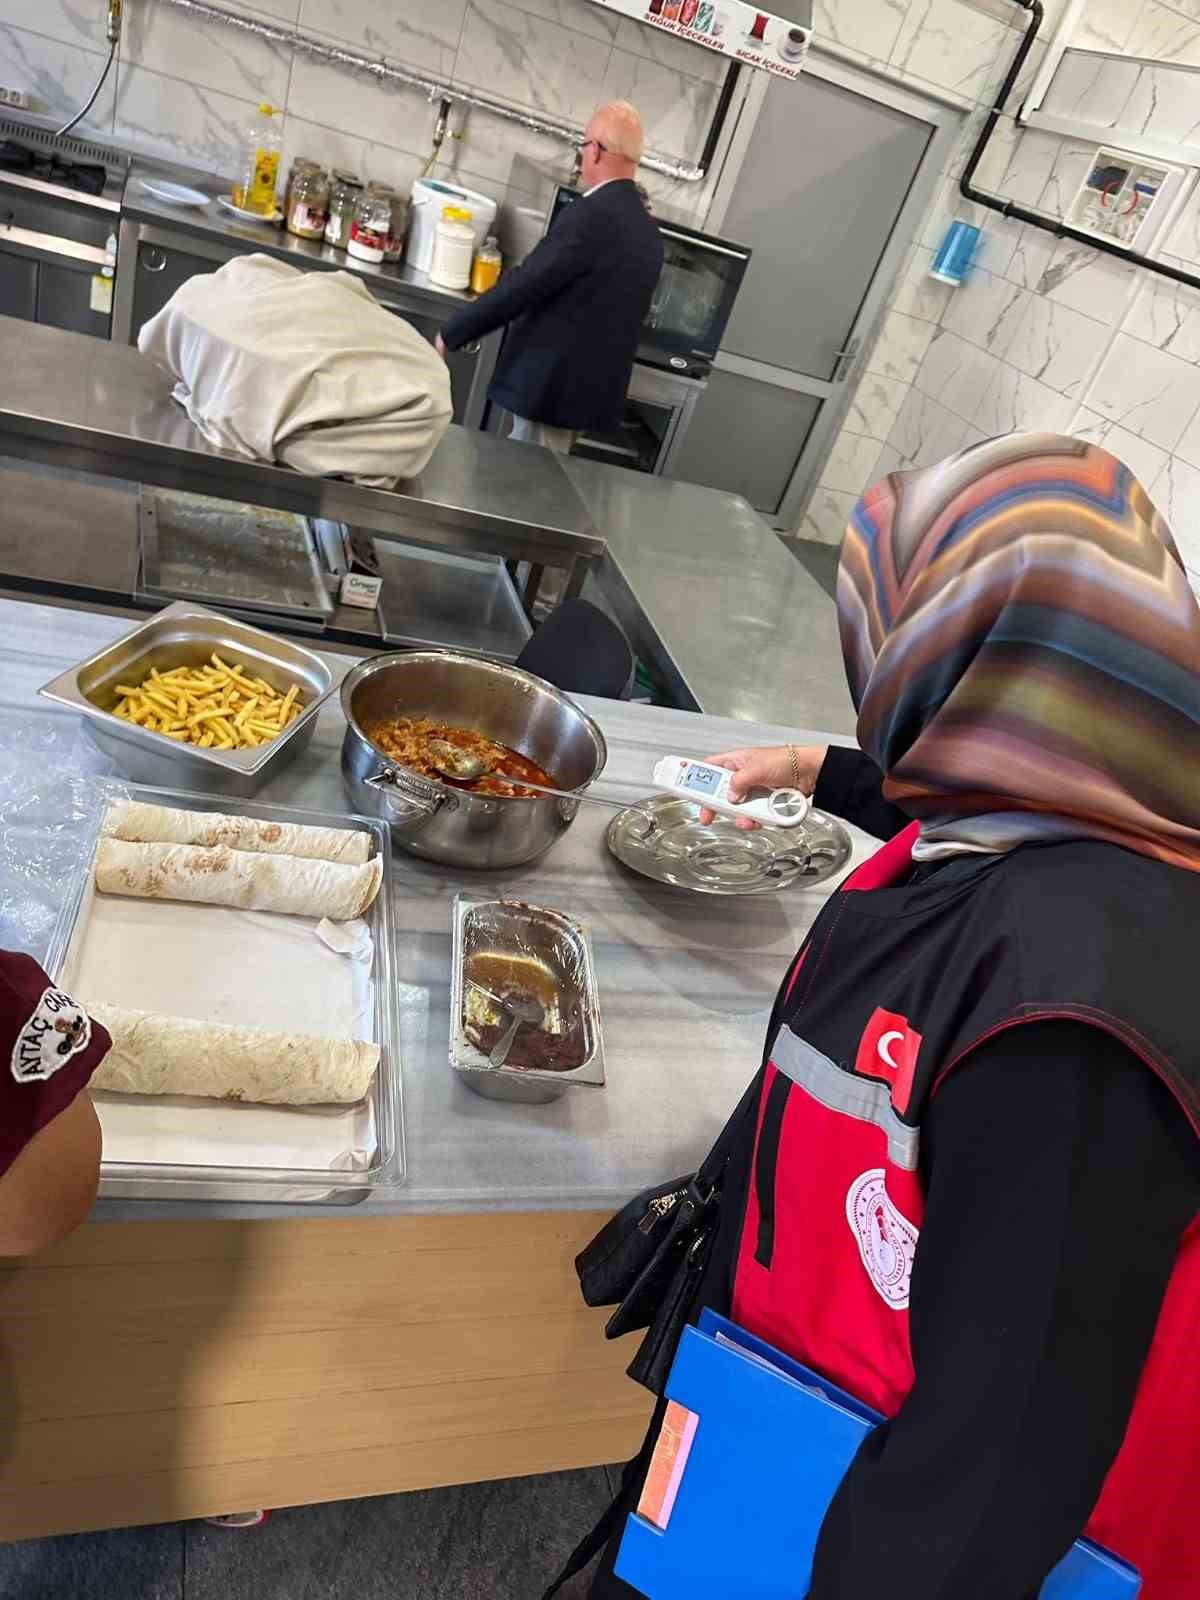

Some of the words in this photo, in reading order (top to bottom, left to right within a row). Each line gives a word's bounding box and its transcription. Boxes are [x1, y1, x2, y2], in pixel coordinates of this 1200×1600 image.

[645, 14, 676, 30] SOĞUK
[677, 25, 725, 49] İÇECEKLER
[736, 49, 761, 63] SICAK
[21, 1017, 53, 1075] AYTAÇ
